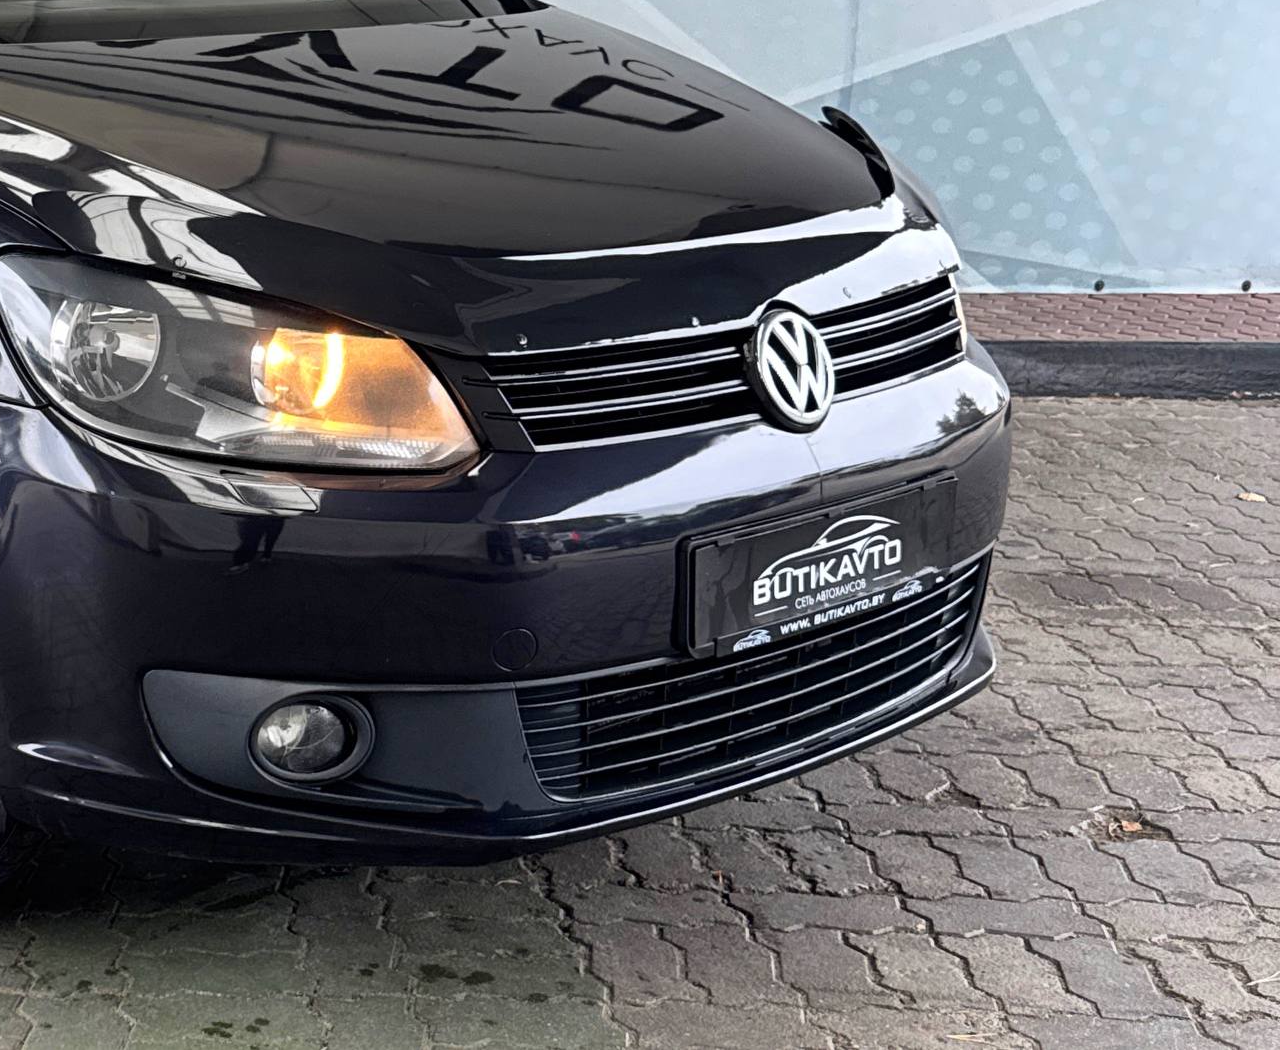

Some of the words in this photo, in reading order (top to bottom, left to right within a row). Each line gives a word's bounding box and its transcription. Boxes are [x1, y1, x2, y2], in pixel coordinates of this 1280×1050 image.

[753, 539, 901, 606] BUTIKAVTO
[795, 595, 815, 609] СЕТЬ
[816, 578, 867, 602] АВТОХАУСОВ
